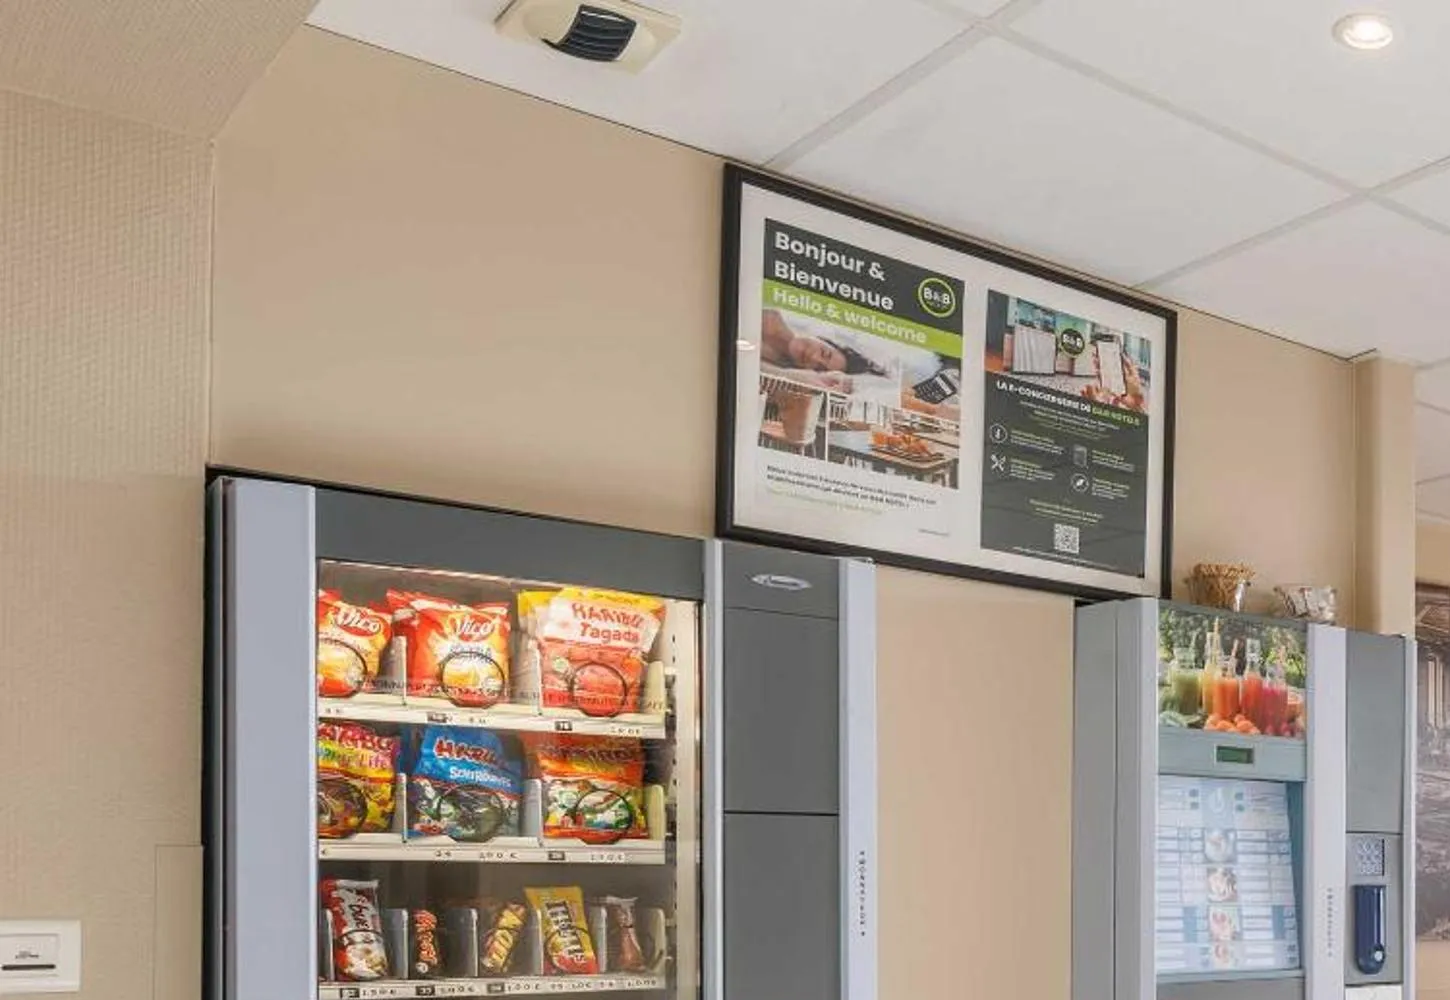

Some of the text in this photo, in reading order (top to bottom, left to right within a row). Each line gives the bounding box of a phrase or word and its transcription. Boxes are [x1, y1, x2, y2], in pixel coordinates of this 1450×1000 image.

[774, 231, 886, 281] Bonjour &
[774, 260, 895, 311] Bienvenue
[923, 286, 951, 305] B&B
[773, 287, 928, 344] Hello & welcome
[335, 606, 381, 633] Vico
[455, 613, 494, 637] Vico
[579, 621, 640, 644] Tagada
